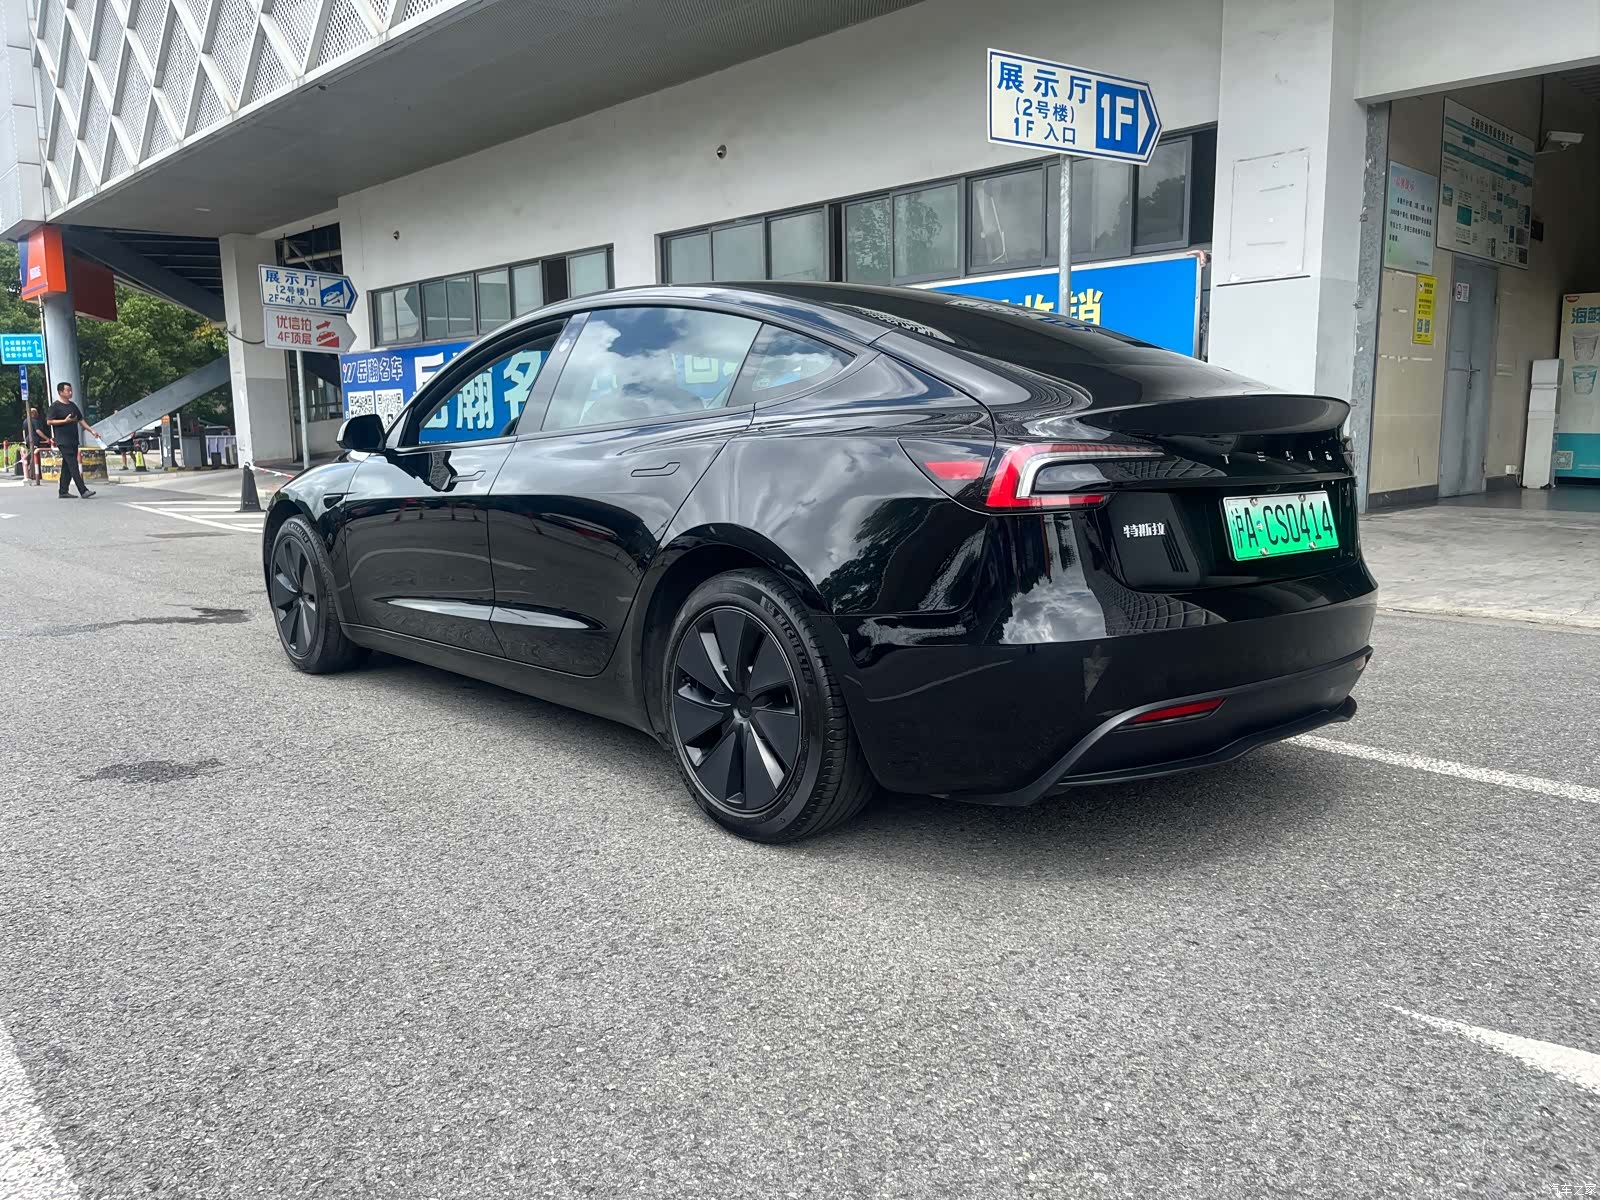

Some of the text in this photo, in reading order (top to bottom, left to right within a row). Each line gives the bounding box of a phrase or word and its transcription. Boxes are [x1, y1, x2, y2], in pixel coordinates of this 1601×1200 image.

[997, 61, 1092, 104] 展示厅
[1100, 93, 1135, 141] 1F
[1044, 122, 1076, 145] 入口
[265, 270, 318, 287] 展示厅
[276, 315, 312, 332] 优信拍
[277, 331, 313, 345] 4F顶层
[357, 356, 403, 383] 岳瀚名车
[1123, 522, 1166, 538] 特斯拉
